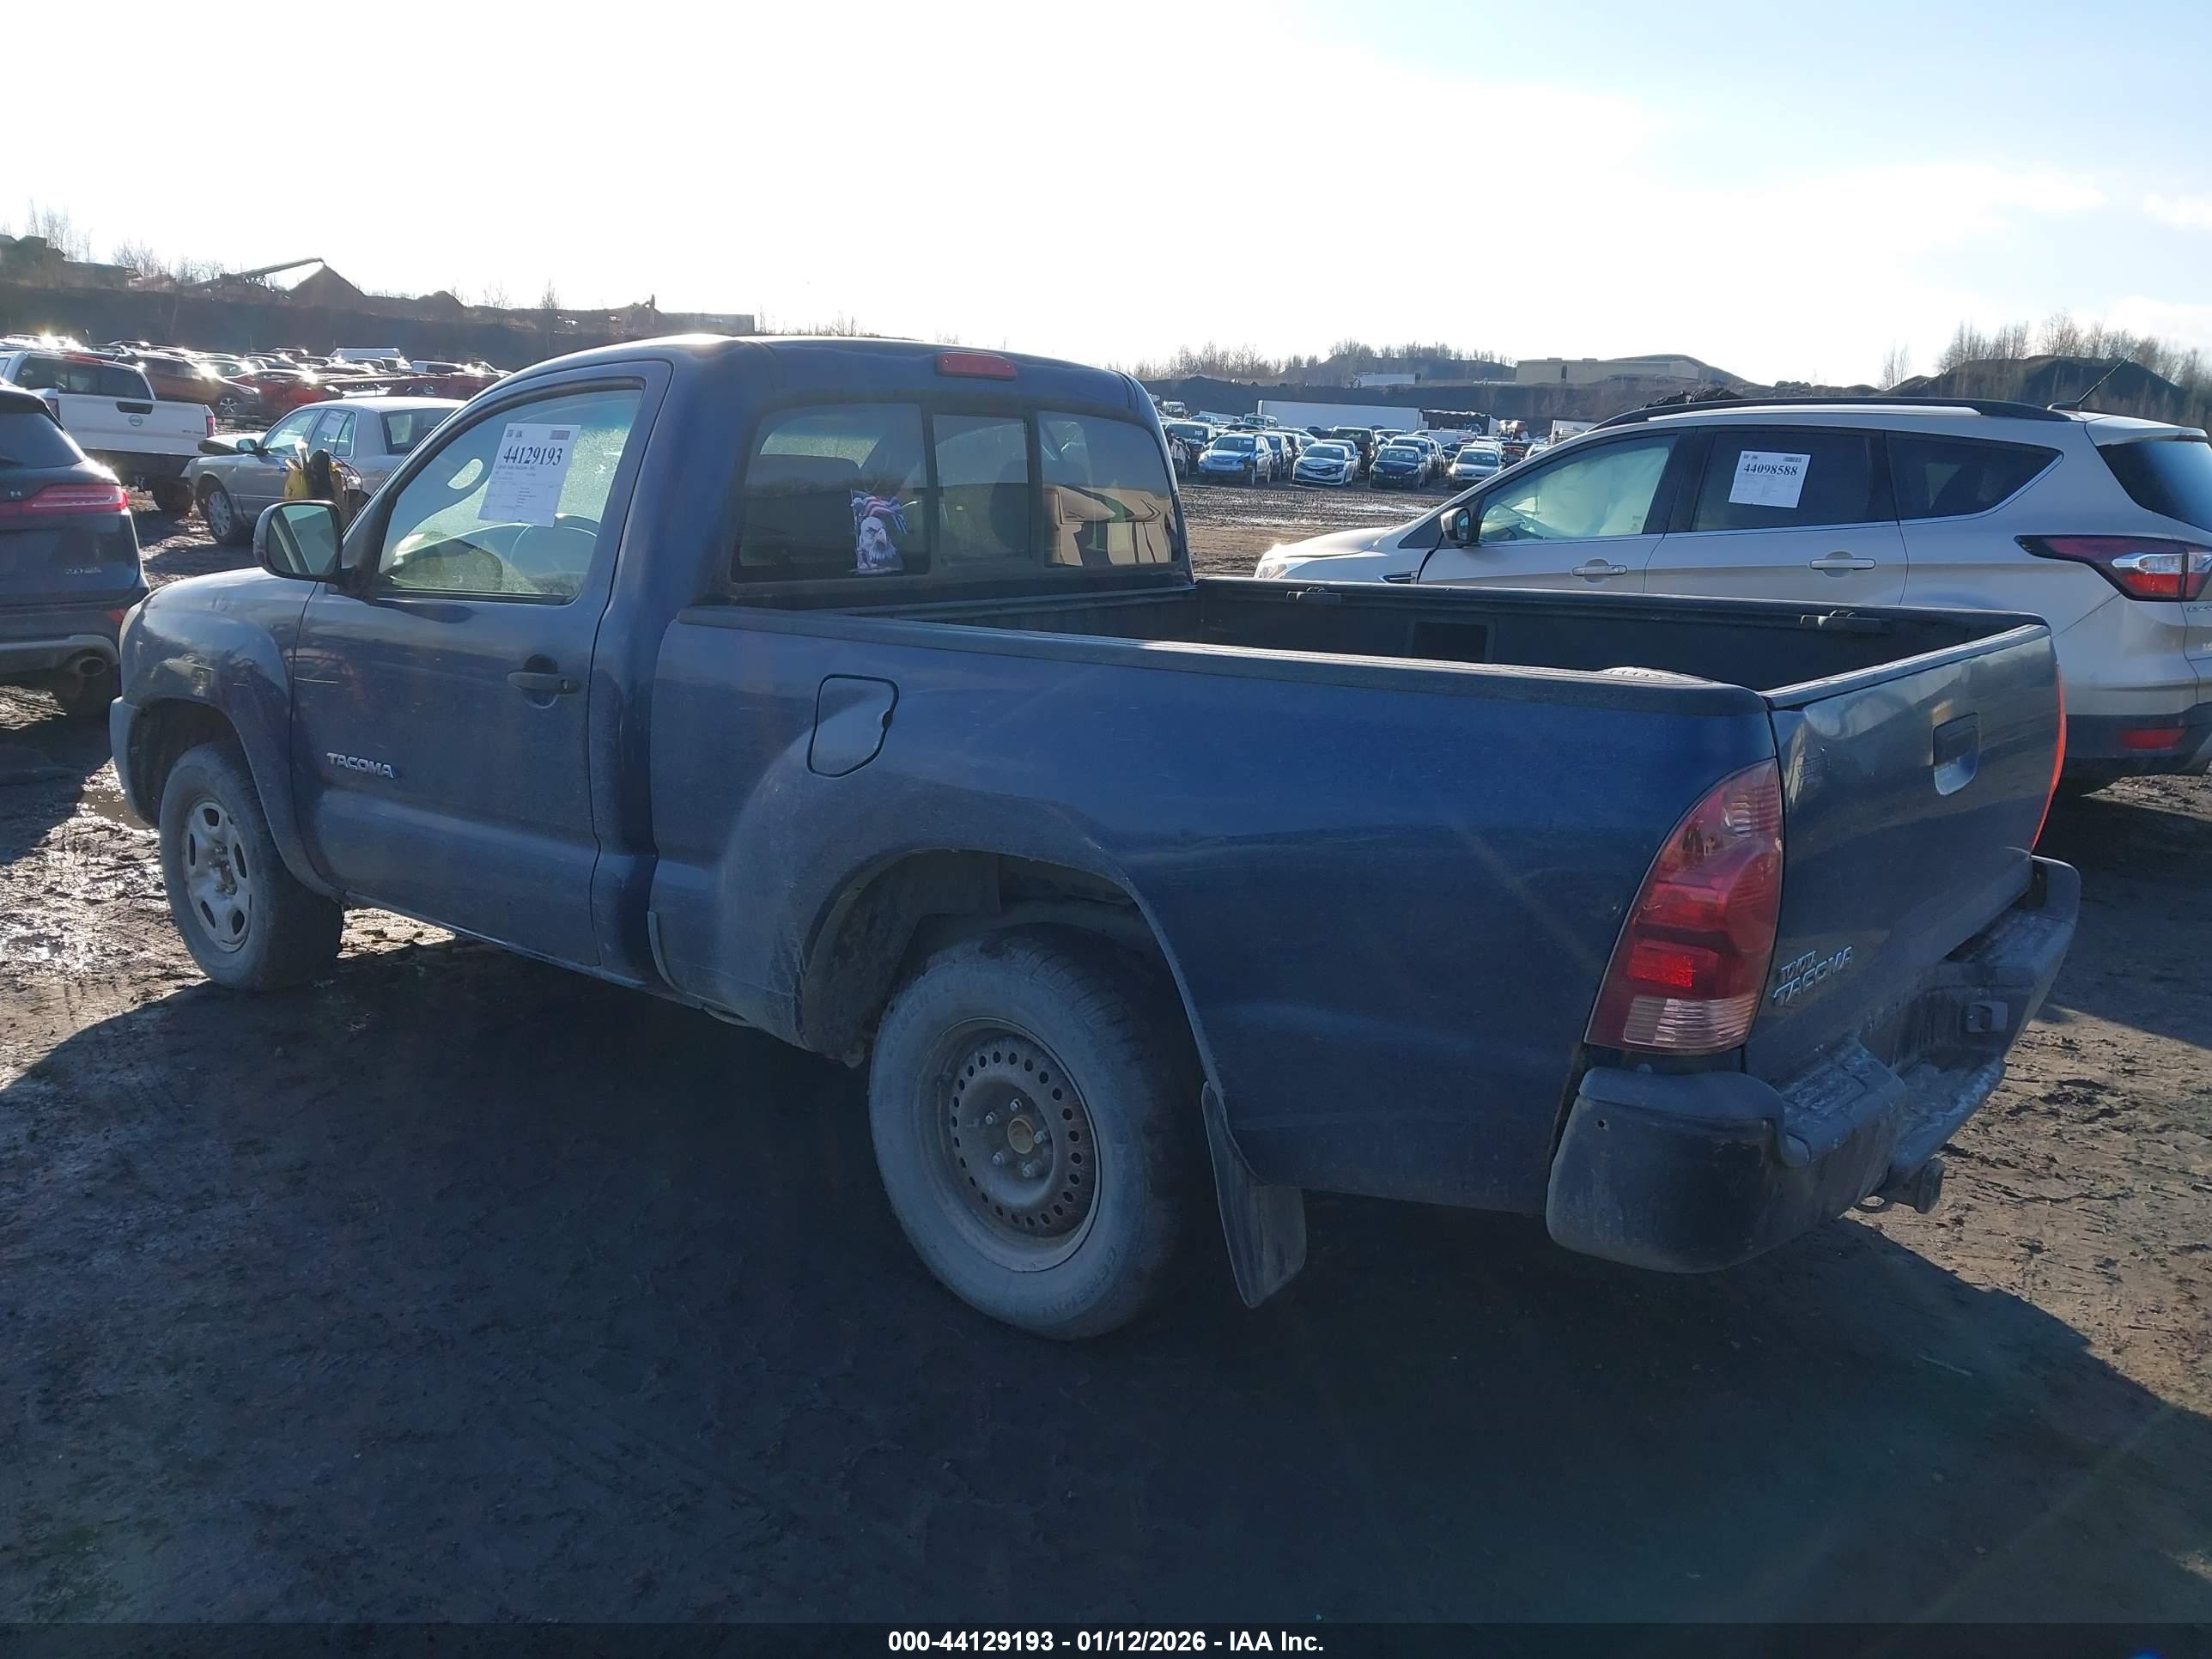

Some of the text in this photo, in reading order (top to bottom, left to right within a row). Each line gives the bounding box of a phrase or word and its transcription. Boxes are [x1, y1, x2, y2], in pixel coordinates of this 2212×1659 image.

[503, 446, 563, 466] 44129193
[1743, 462, 1798, 477] 44098588
[326, 752, 394, 779] TACOMA
[1772, 946, 1852, 1006] TACOMA
